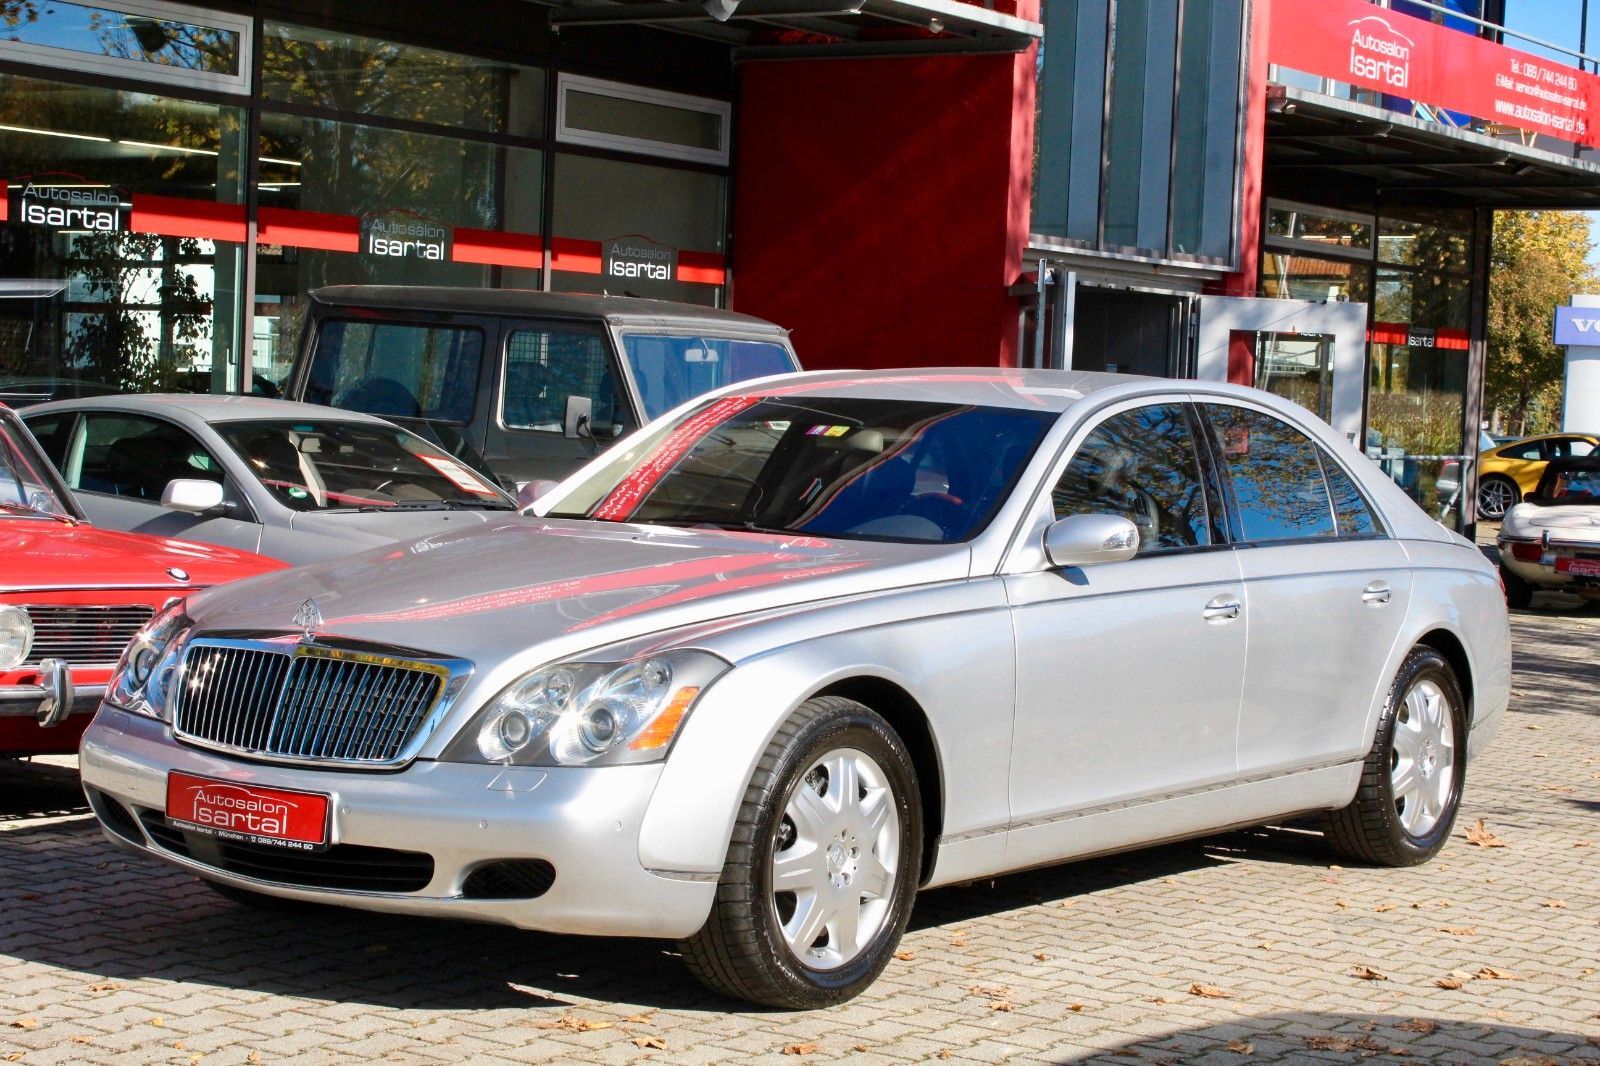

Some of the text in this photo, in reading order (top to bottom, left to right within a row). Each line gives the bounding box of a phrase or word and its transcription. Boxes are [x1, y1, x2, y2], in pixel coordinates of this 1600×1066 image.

[1352, 29, 1410, 60] Autosalon
[1350, 47, 1410, 88] Isartal
[1495, 99, 1585, 135] www.autosalon-isartal.de
[22, 182, 120, 203] Autosalon
[21, 198, 119, 231] Isartal
[371, 218, 445, 239] Autosalon
[368, 234, 445, 261] Isartal
[611, 242, 671, 260] Autosalon
[609, 258, 671, 281] Isartal
[1408, 334, 1435, 348] Isartal
[194, 790, 288, 816] Autosalon
[193, 800, 287, 835] Isartal
[173, 820, 196, 831] Autosalon
[218, 830, 244, 841] München
[288, 841, 302, 849] 244
